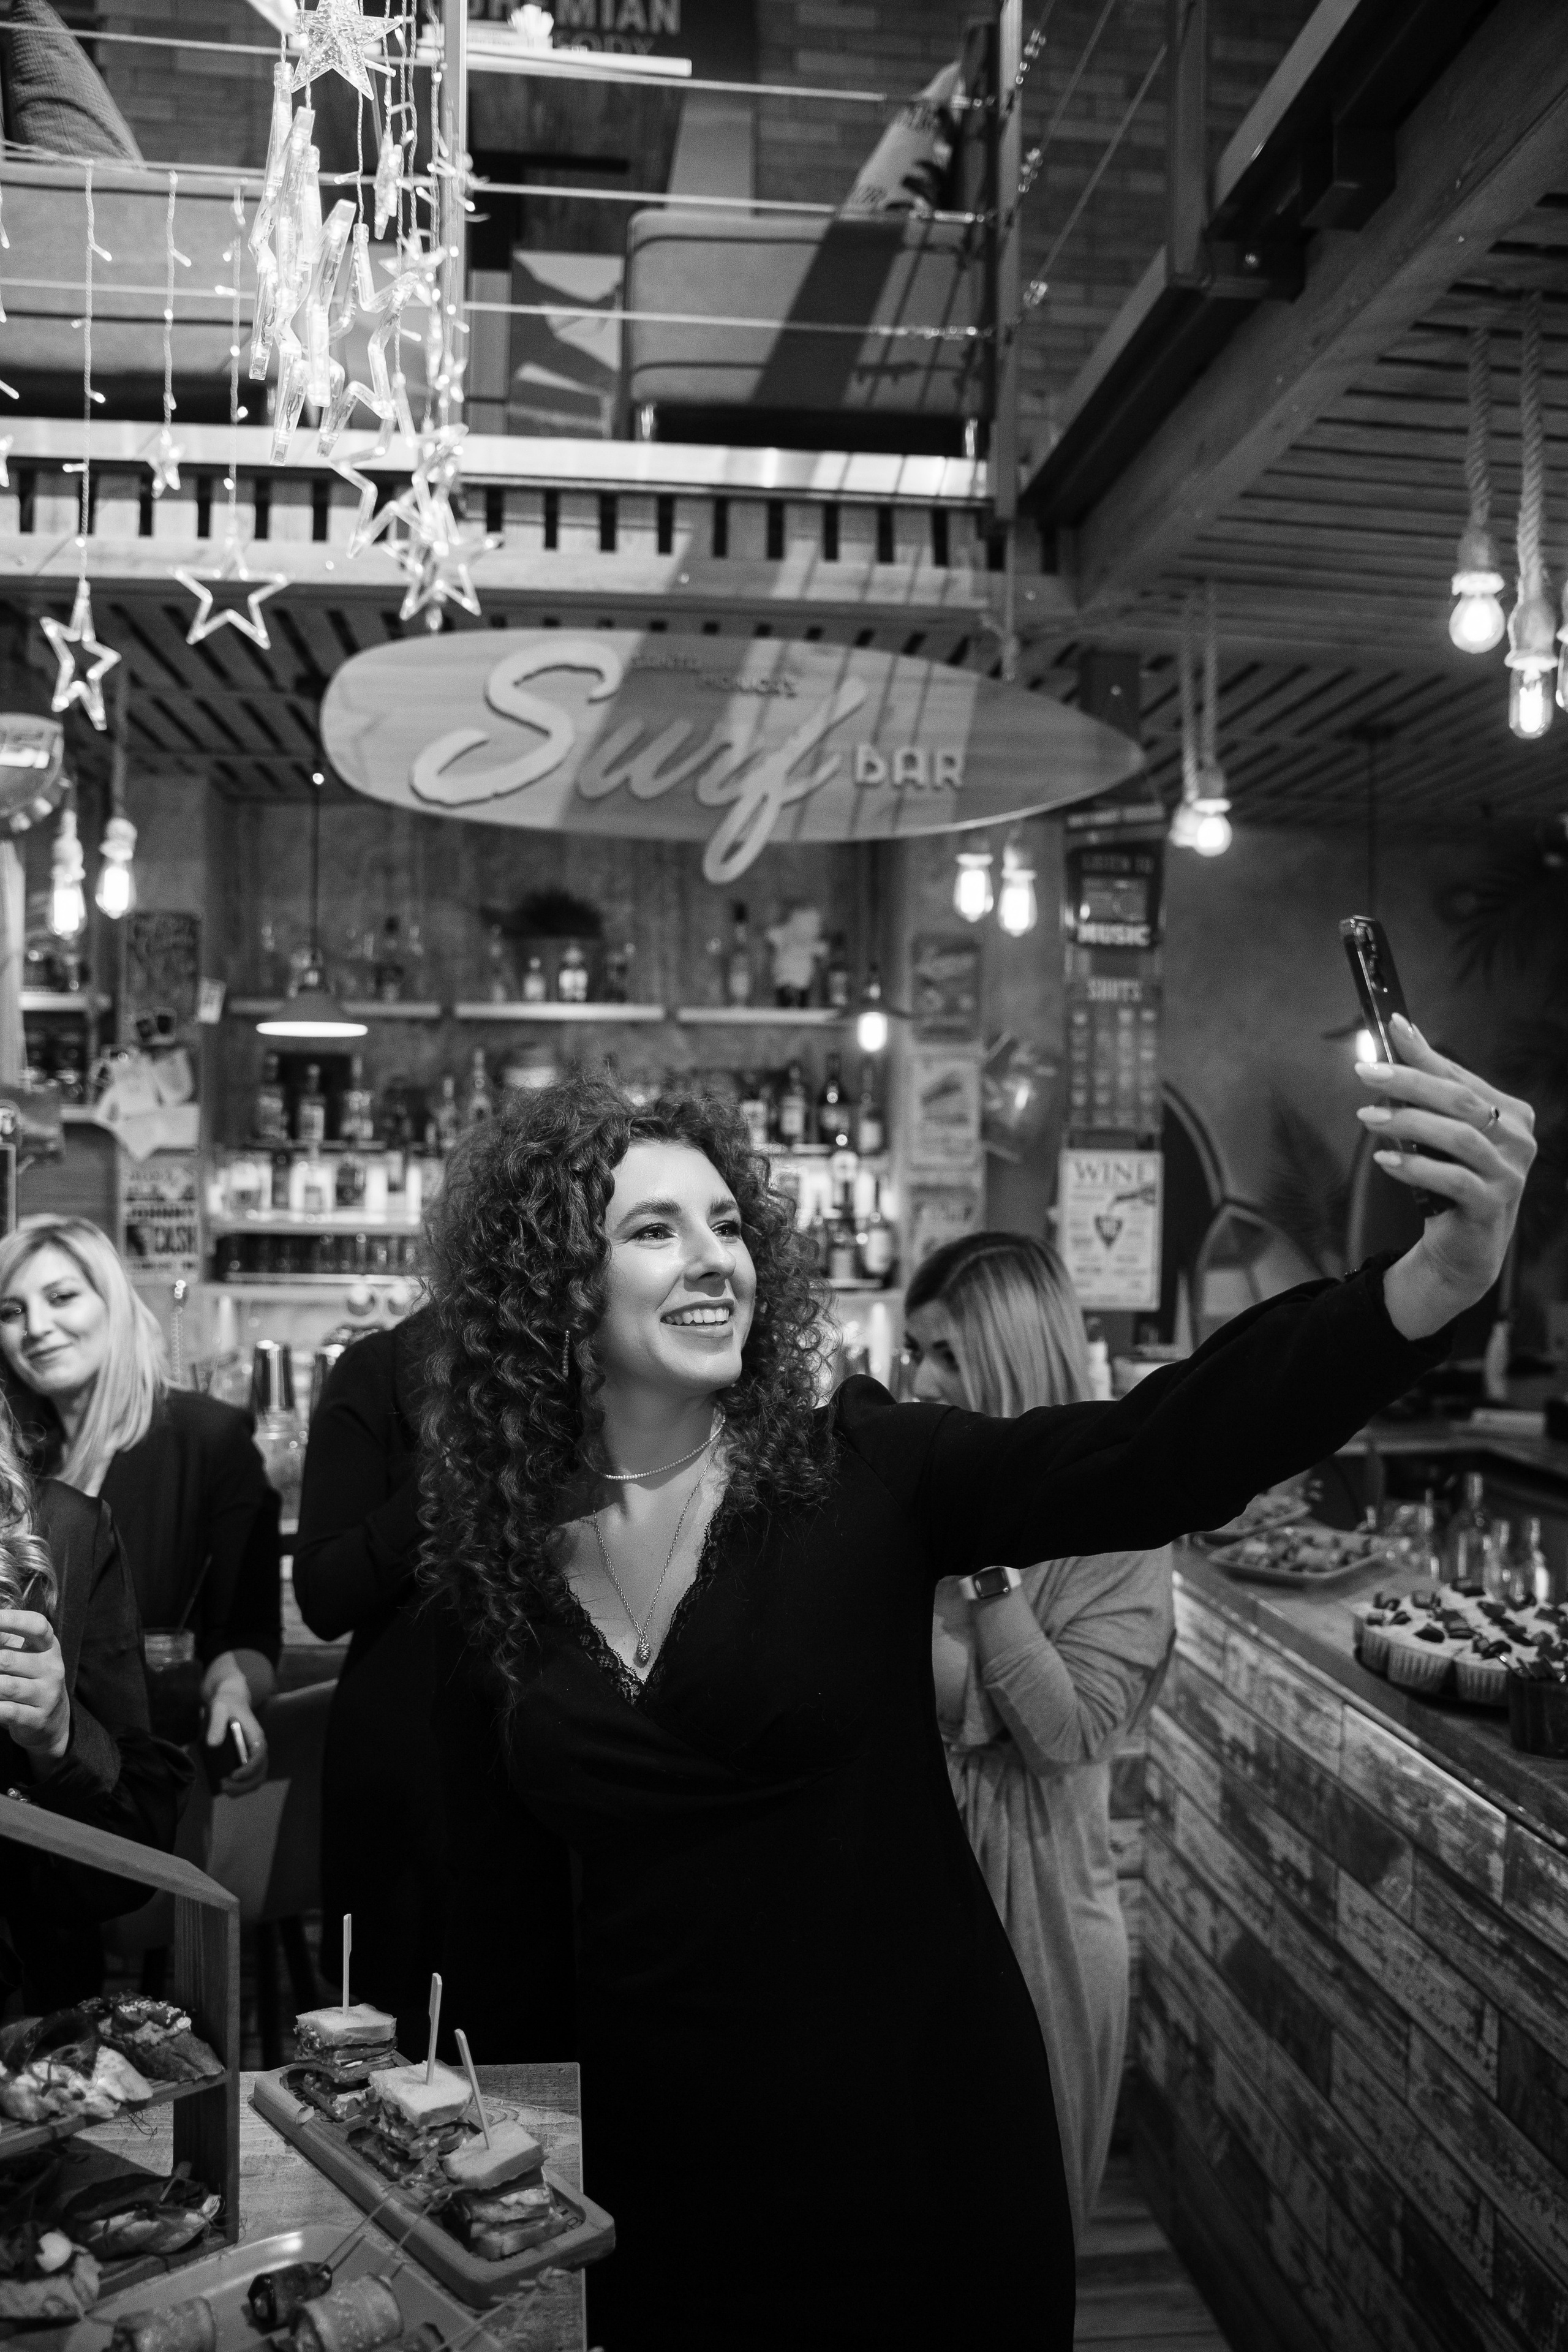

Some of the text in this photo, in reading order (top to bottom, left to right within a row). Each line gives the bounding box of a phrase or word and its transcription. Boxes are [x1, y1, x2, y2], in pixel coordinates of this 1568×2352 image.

[412, 638, 869, 883] Surf
[855, 744, 964, 786] BAR
[1078, 922, 1151, 946] MUSIC
